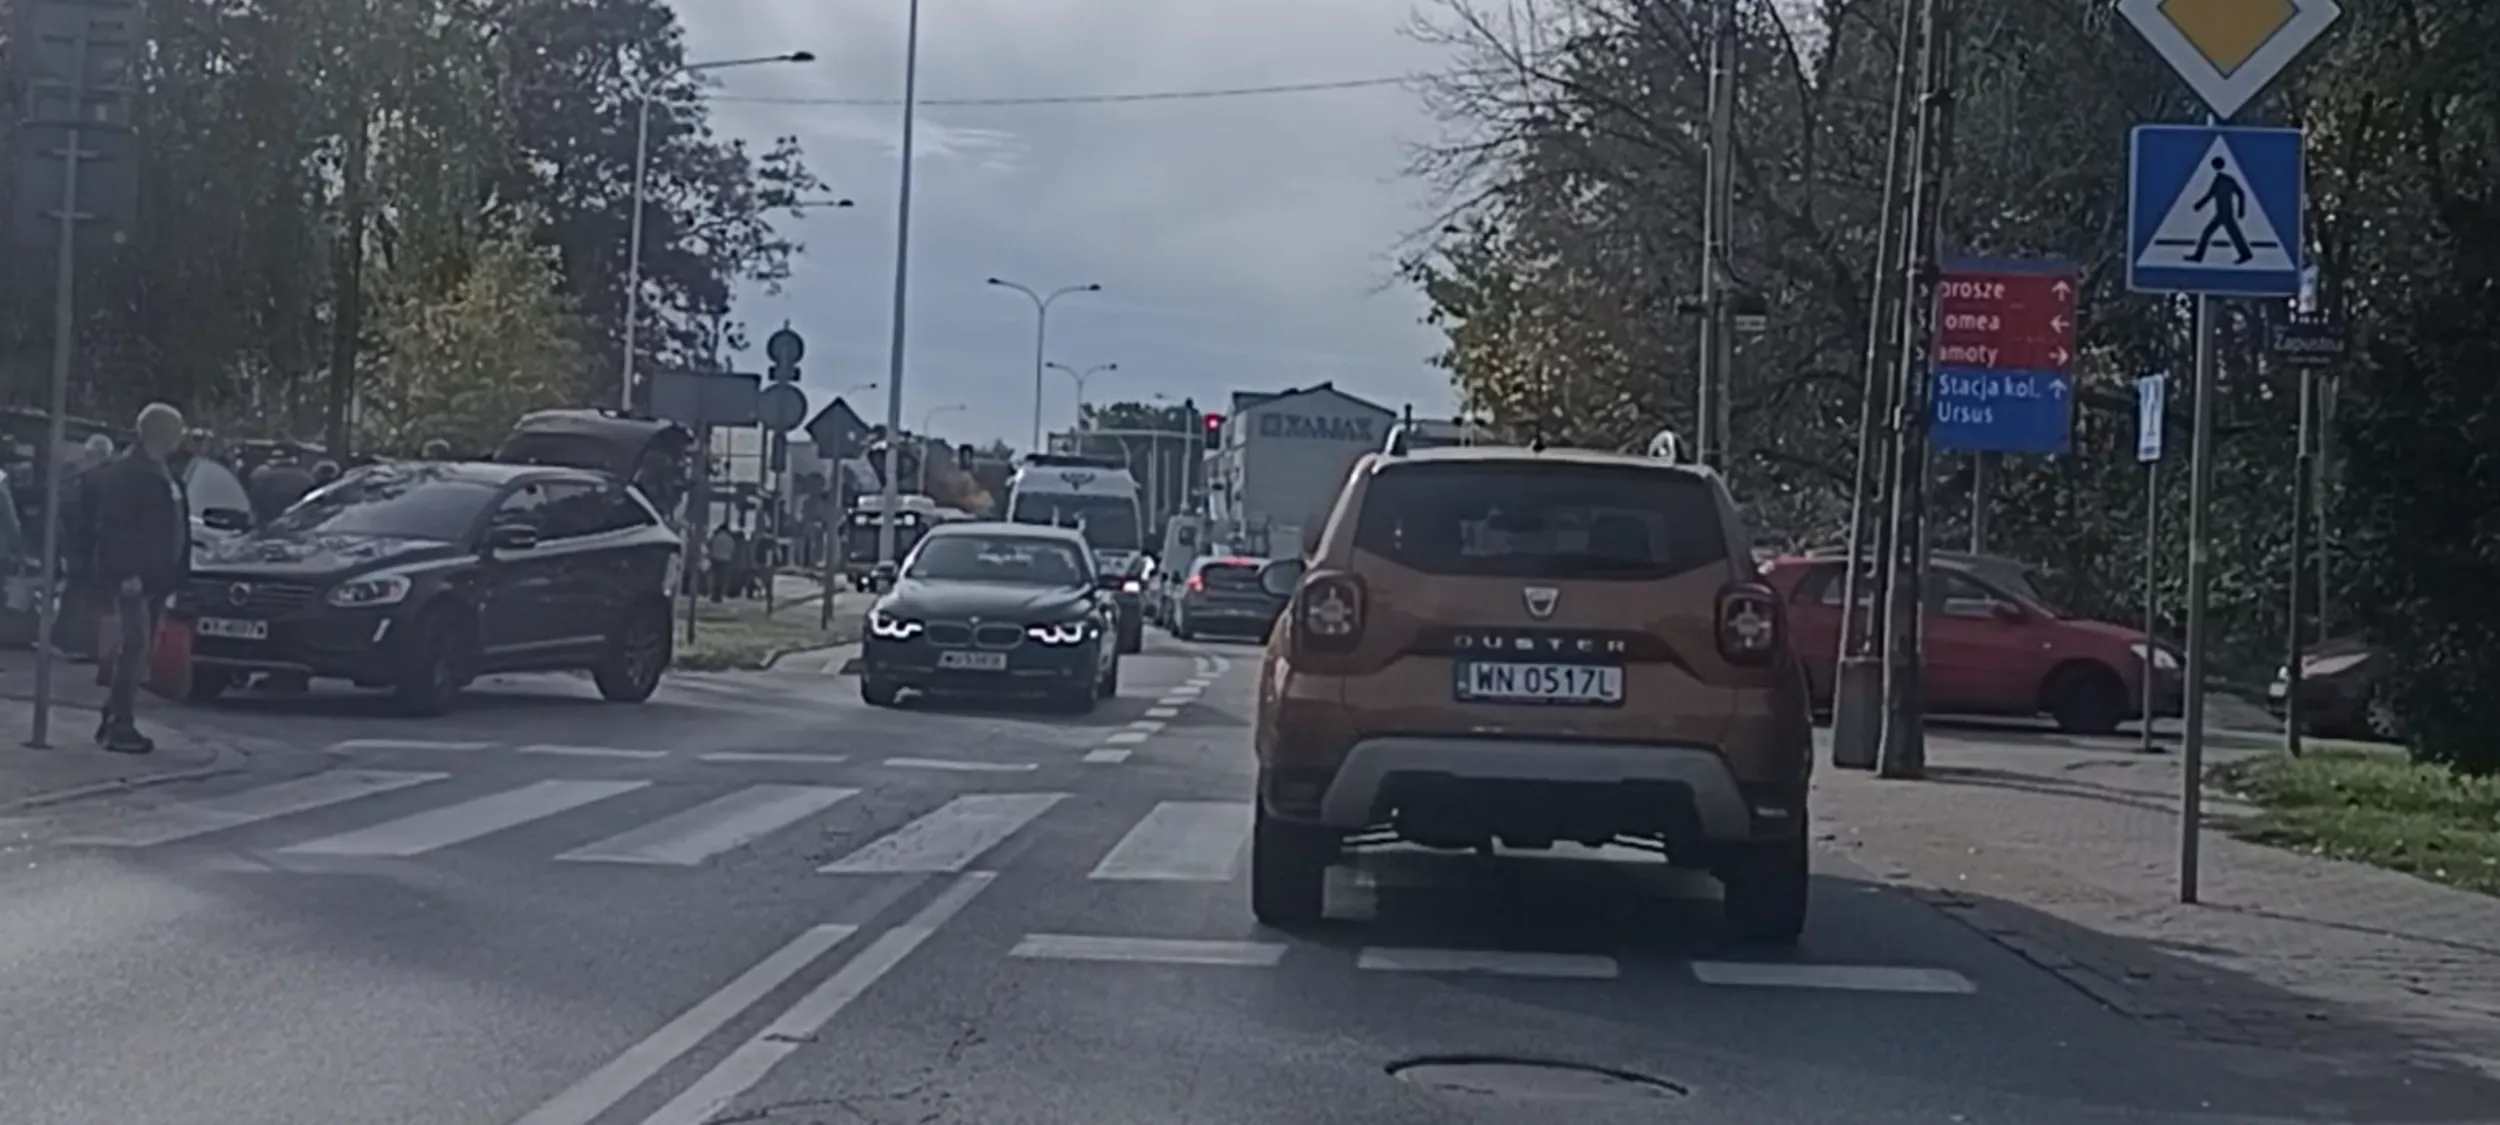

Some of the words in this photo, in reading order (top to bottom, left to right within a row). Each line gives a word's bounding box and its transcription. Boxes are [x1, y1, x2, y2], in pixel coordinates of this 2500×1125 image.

[1939, 374, 1999, 401] Stacja
[2005, 376, 2041, 398] kol.
[1937, 403, 1993, 422] Ursus
[1454, 634, 1626, 652] DUSTER
[1477, 664, 1515, 692] WN
[1523, 667, 1614, 697] 0517L
